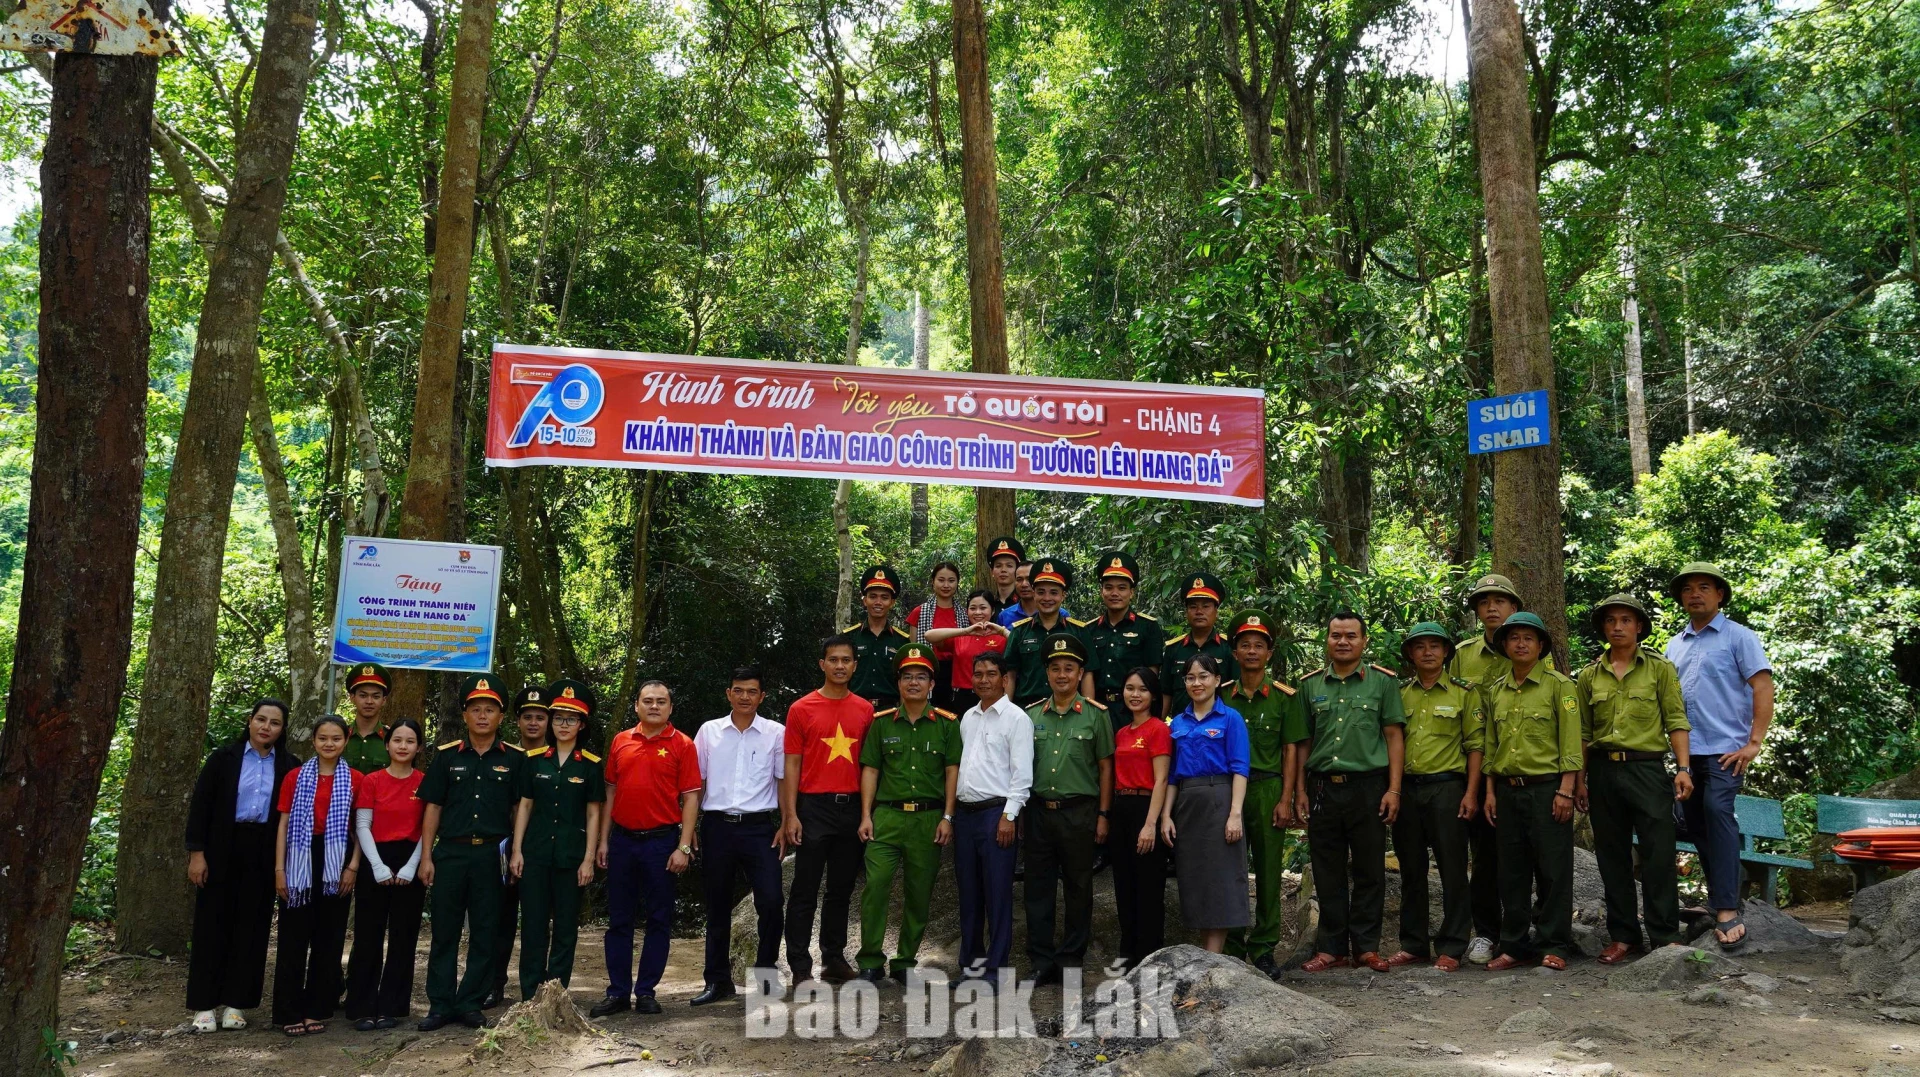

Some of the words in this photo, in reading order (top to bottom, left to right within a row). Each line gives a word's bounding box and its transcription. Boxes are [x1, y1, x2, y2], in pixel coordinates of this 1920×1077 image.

[640, 371, 726, 407] Hành
[734, 377, 816, 410] Trình
[873, 393, 935, 434] yêu
[943, 390, 977, 415] TỔ
[985, 394, 1056, 419] QUỐC
[1063, 400, 1104, 422] TÔI
[1137, 406, 1202, 436] CHẶNG
[1209, 414, 1221, 436] 4
[1480, 396, 1536, 423] SUỐI
[540, 426, 577, 443] 15-10
[577, 428, 593, 436] 1956
[1478, 427, 1540, 451] SNAR
[625, 419, 694, 453] KHÁNH
[700, 422, 764, 457] THÀNH
[771, 426, 795, 459] VÀ
[802, 428, 842, 461] BÀN
[850, 435, 892, 463] GIAO
[900, 433, 952, 466] CÔNG
[958, 436, 1014, 469] TRÌNH
[1021, 440, 1096, 475] "ĐƯỜNG
[1102, 445, 1136, 477] LÊN
[1142, 453, 1192, 481] HANG
[1197, 452, 1231, 484] ĐÁ"
[395, 574, 442, 594] Tặng
[359, 595, 386, 605] CÔNG
[419, 600, 450, 609] THANH
[453, 602, 476, 611] NIÊN
[423, 611, 450, 620] HANG
